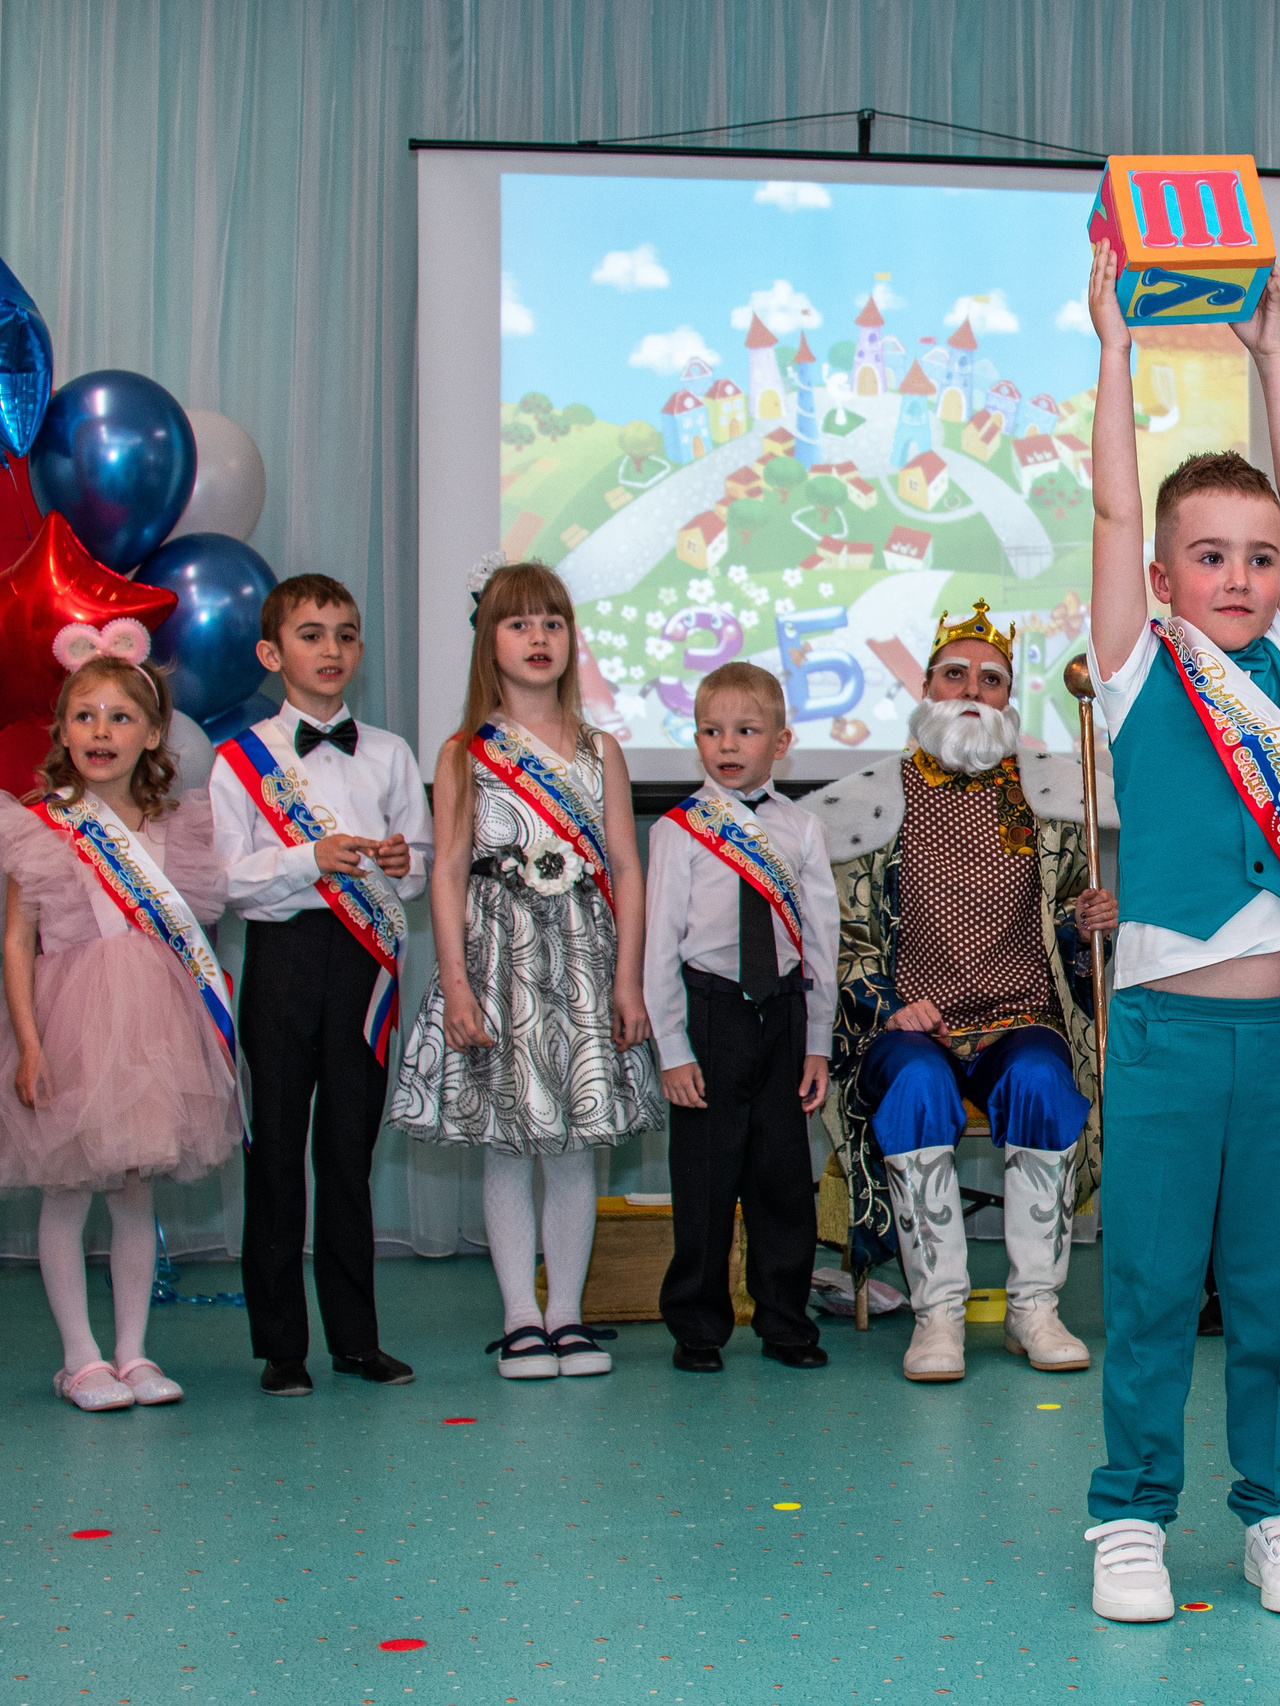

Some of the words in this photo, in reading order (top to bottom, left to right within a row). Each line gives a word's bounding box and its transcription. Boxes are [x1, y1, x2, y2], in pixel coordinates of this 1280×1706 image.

[515, 770, 580, 837] ДЕТСКОГО
[1233, 747, 1273, 808] САДА
[76, 835, 139, 908] ДЕТСКОГО
[87, 823, 192, 949] Выпускник
[719, 840, 784, 903] ДЕТСКОГО
[338, 891, 371, 929] САДА
